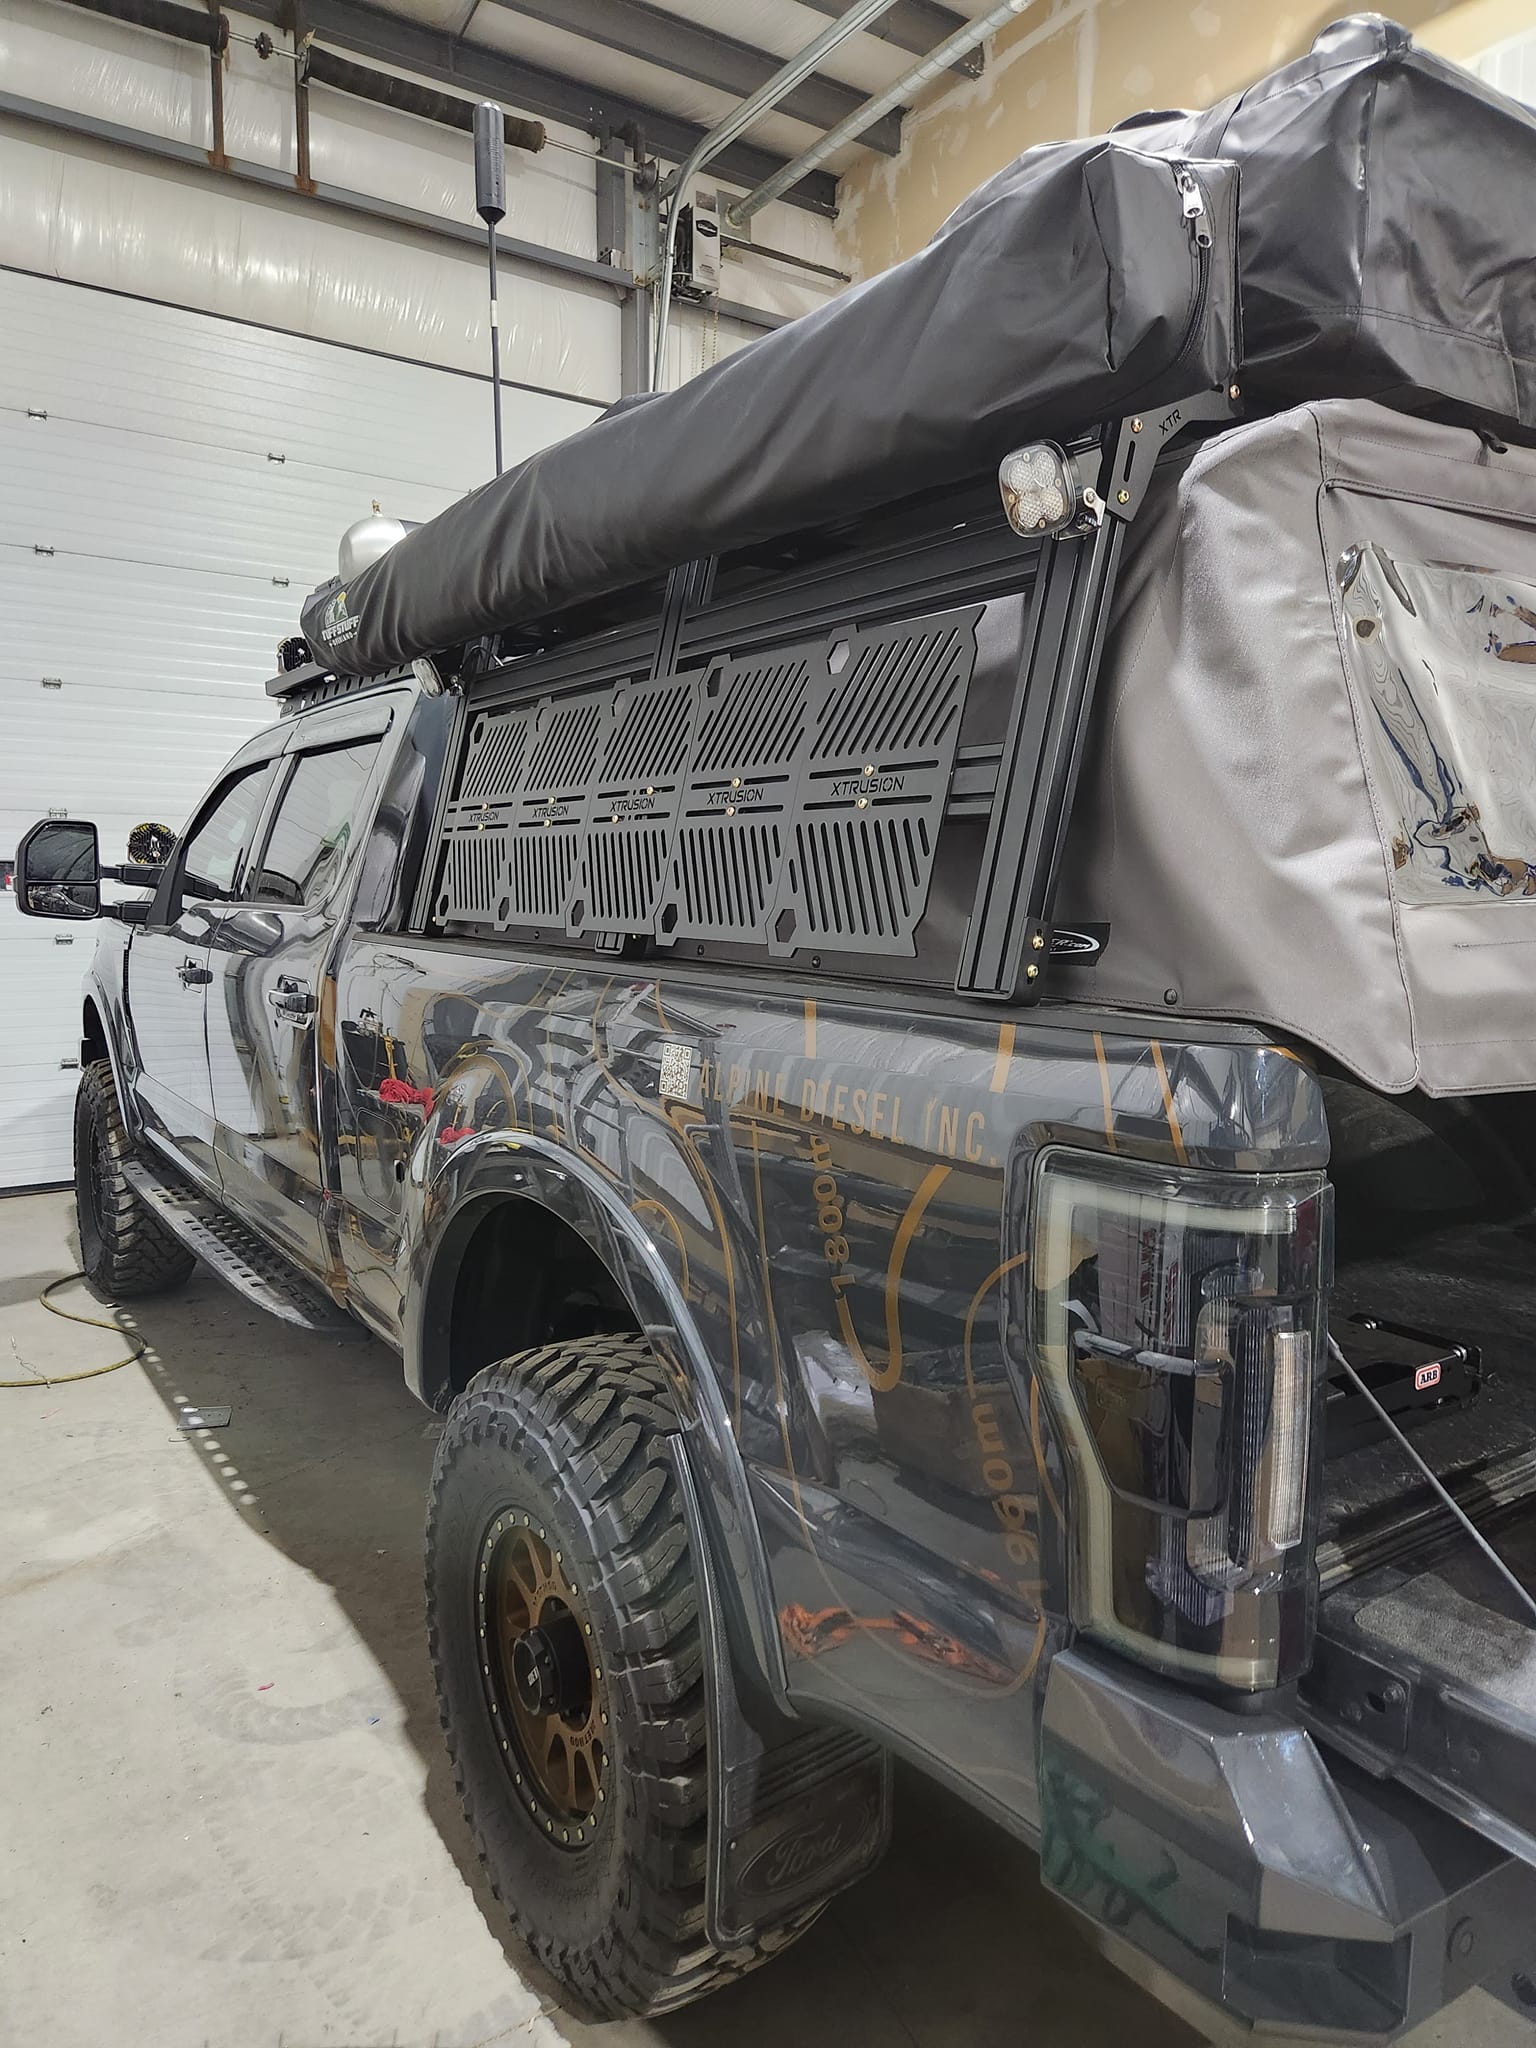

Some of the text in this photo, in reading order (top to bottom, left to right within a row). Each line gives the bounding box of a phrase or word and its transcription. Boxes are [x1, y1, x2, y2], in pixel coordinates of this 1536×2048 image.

[1159, 409, 1182, 435] XTR
[707, 788, 764, 806] XTRUSION
[831, 776, 905, 797] XTRUSION
[532, 805, 569, 819] XTRUSION
[609, 797, 656, 813] XTRUSION
[700, 1057, 997, 1166] ALPINE DIESEL INC.
[810, 1134, 856, 1294] 1800m
[1420, 1369, 1438, 1385] ARB
[766, 1821, 843, 1885] Ford
